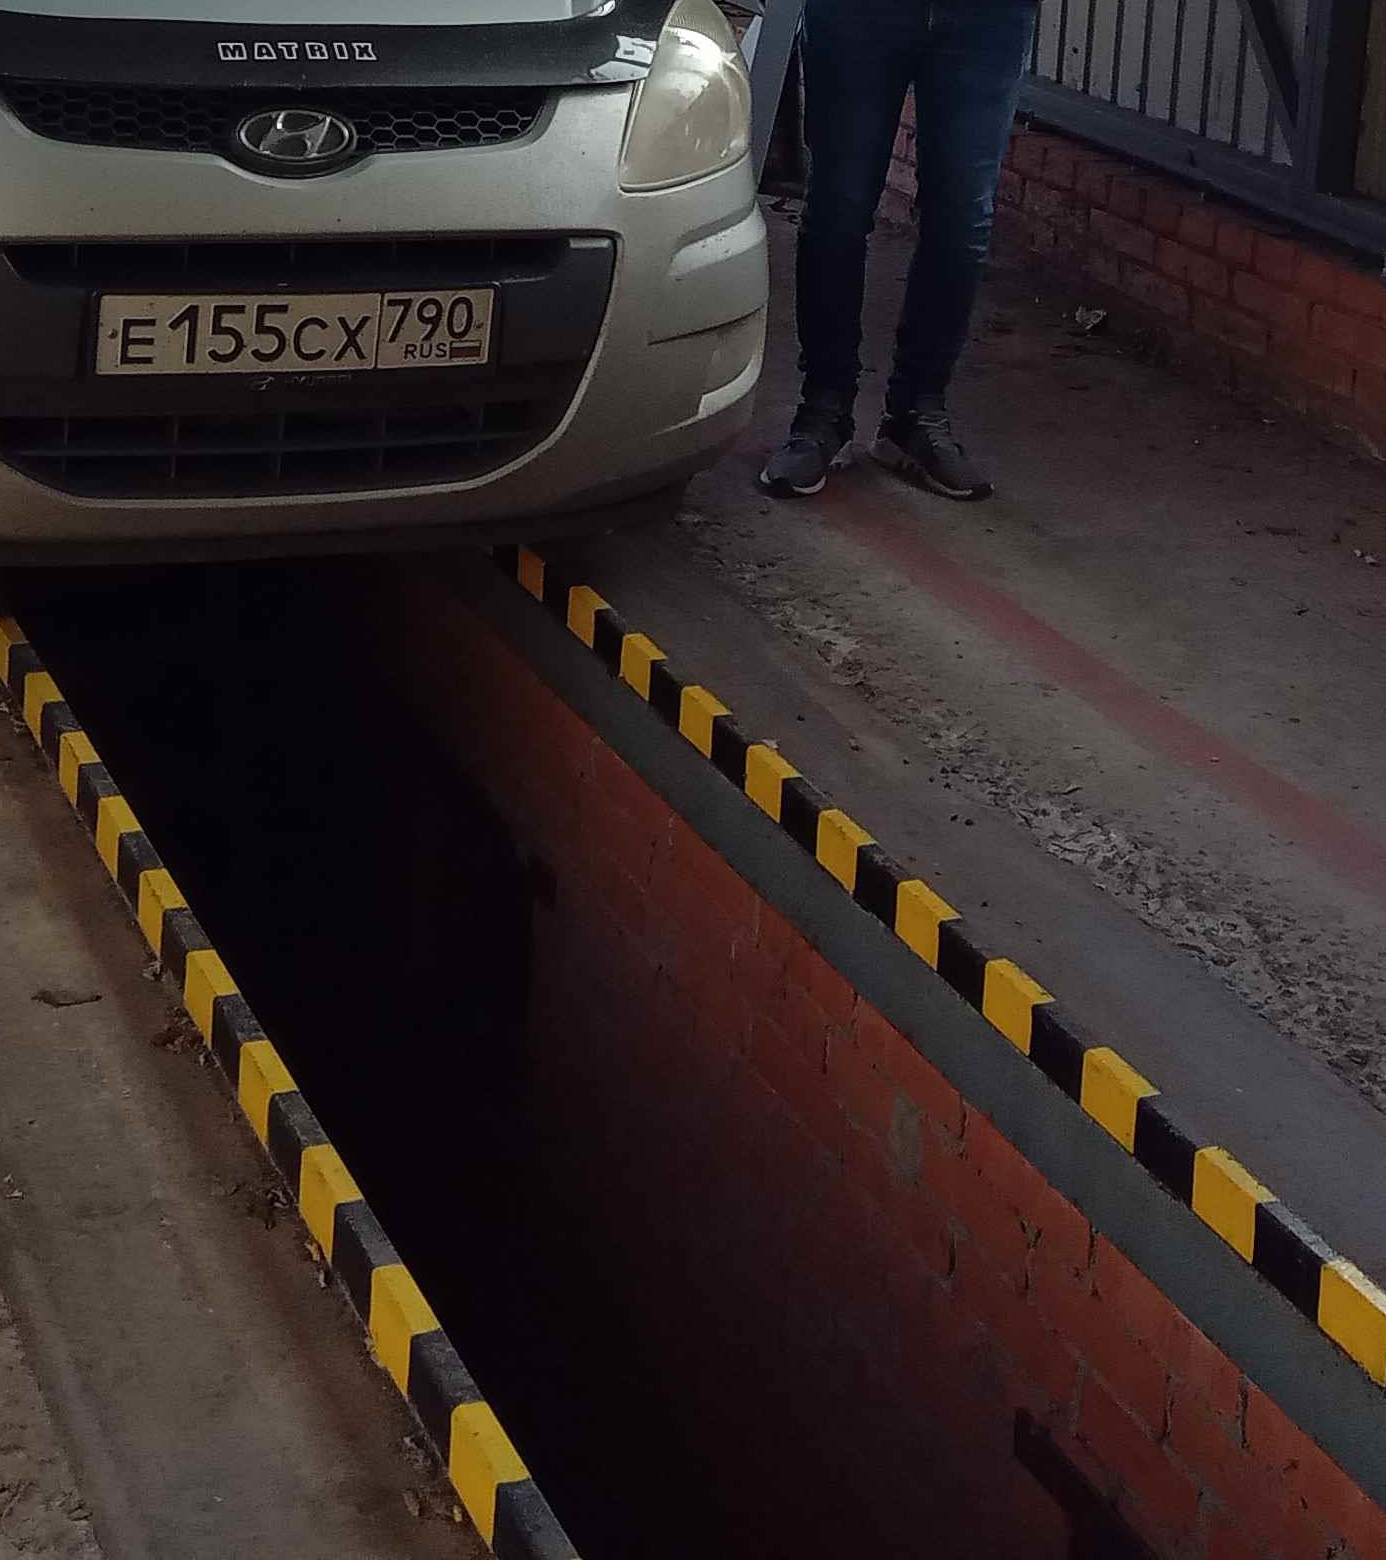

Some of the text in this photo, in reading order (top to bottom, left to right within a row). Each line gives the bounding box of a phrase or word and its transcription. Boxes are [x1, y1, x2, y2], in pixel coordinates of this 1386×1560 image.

[217, 42, 378, 62] MATRIX
[386, 296, 474, 343] 790
[404, 342, 447, 360] RUS
